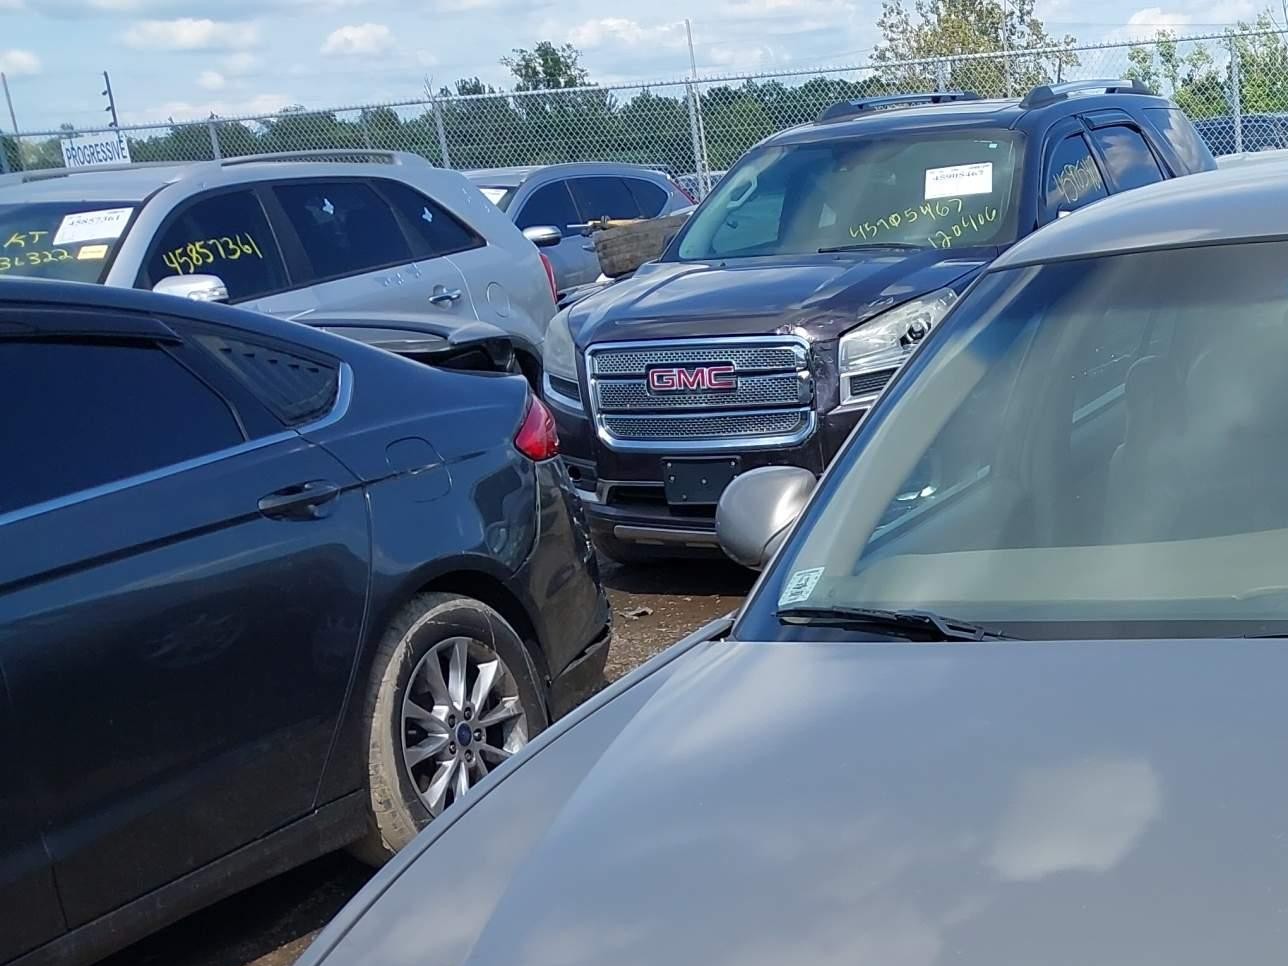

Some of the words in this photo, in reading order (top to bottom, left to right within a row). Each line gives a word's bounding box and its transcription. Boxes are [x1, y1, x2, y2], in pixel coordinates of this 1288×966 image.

[65, 139, 128, 167] PROGRESSIVE
[162, 232, 263, 275] 45857361
[649, 365, 737, 390] GMC
